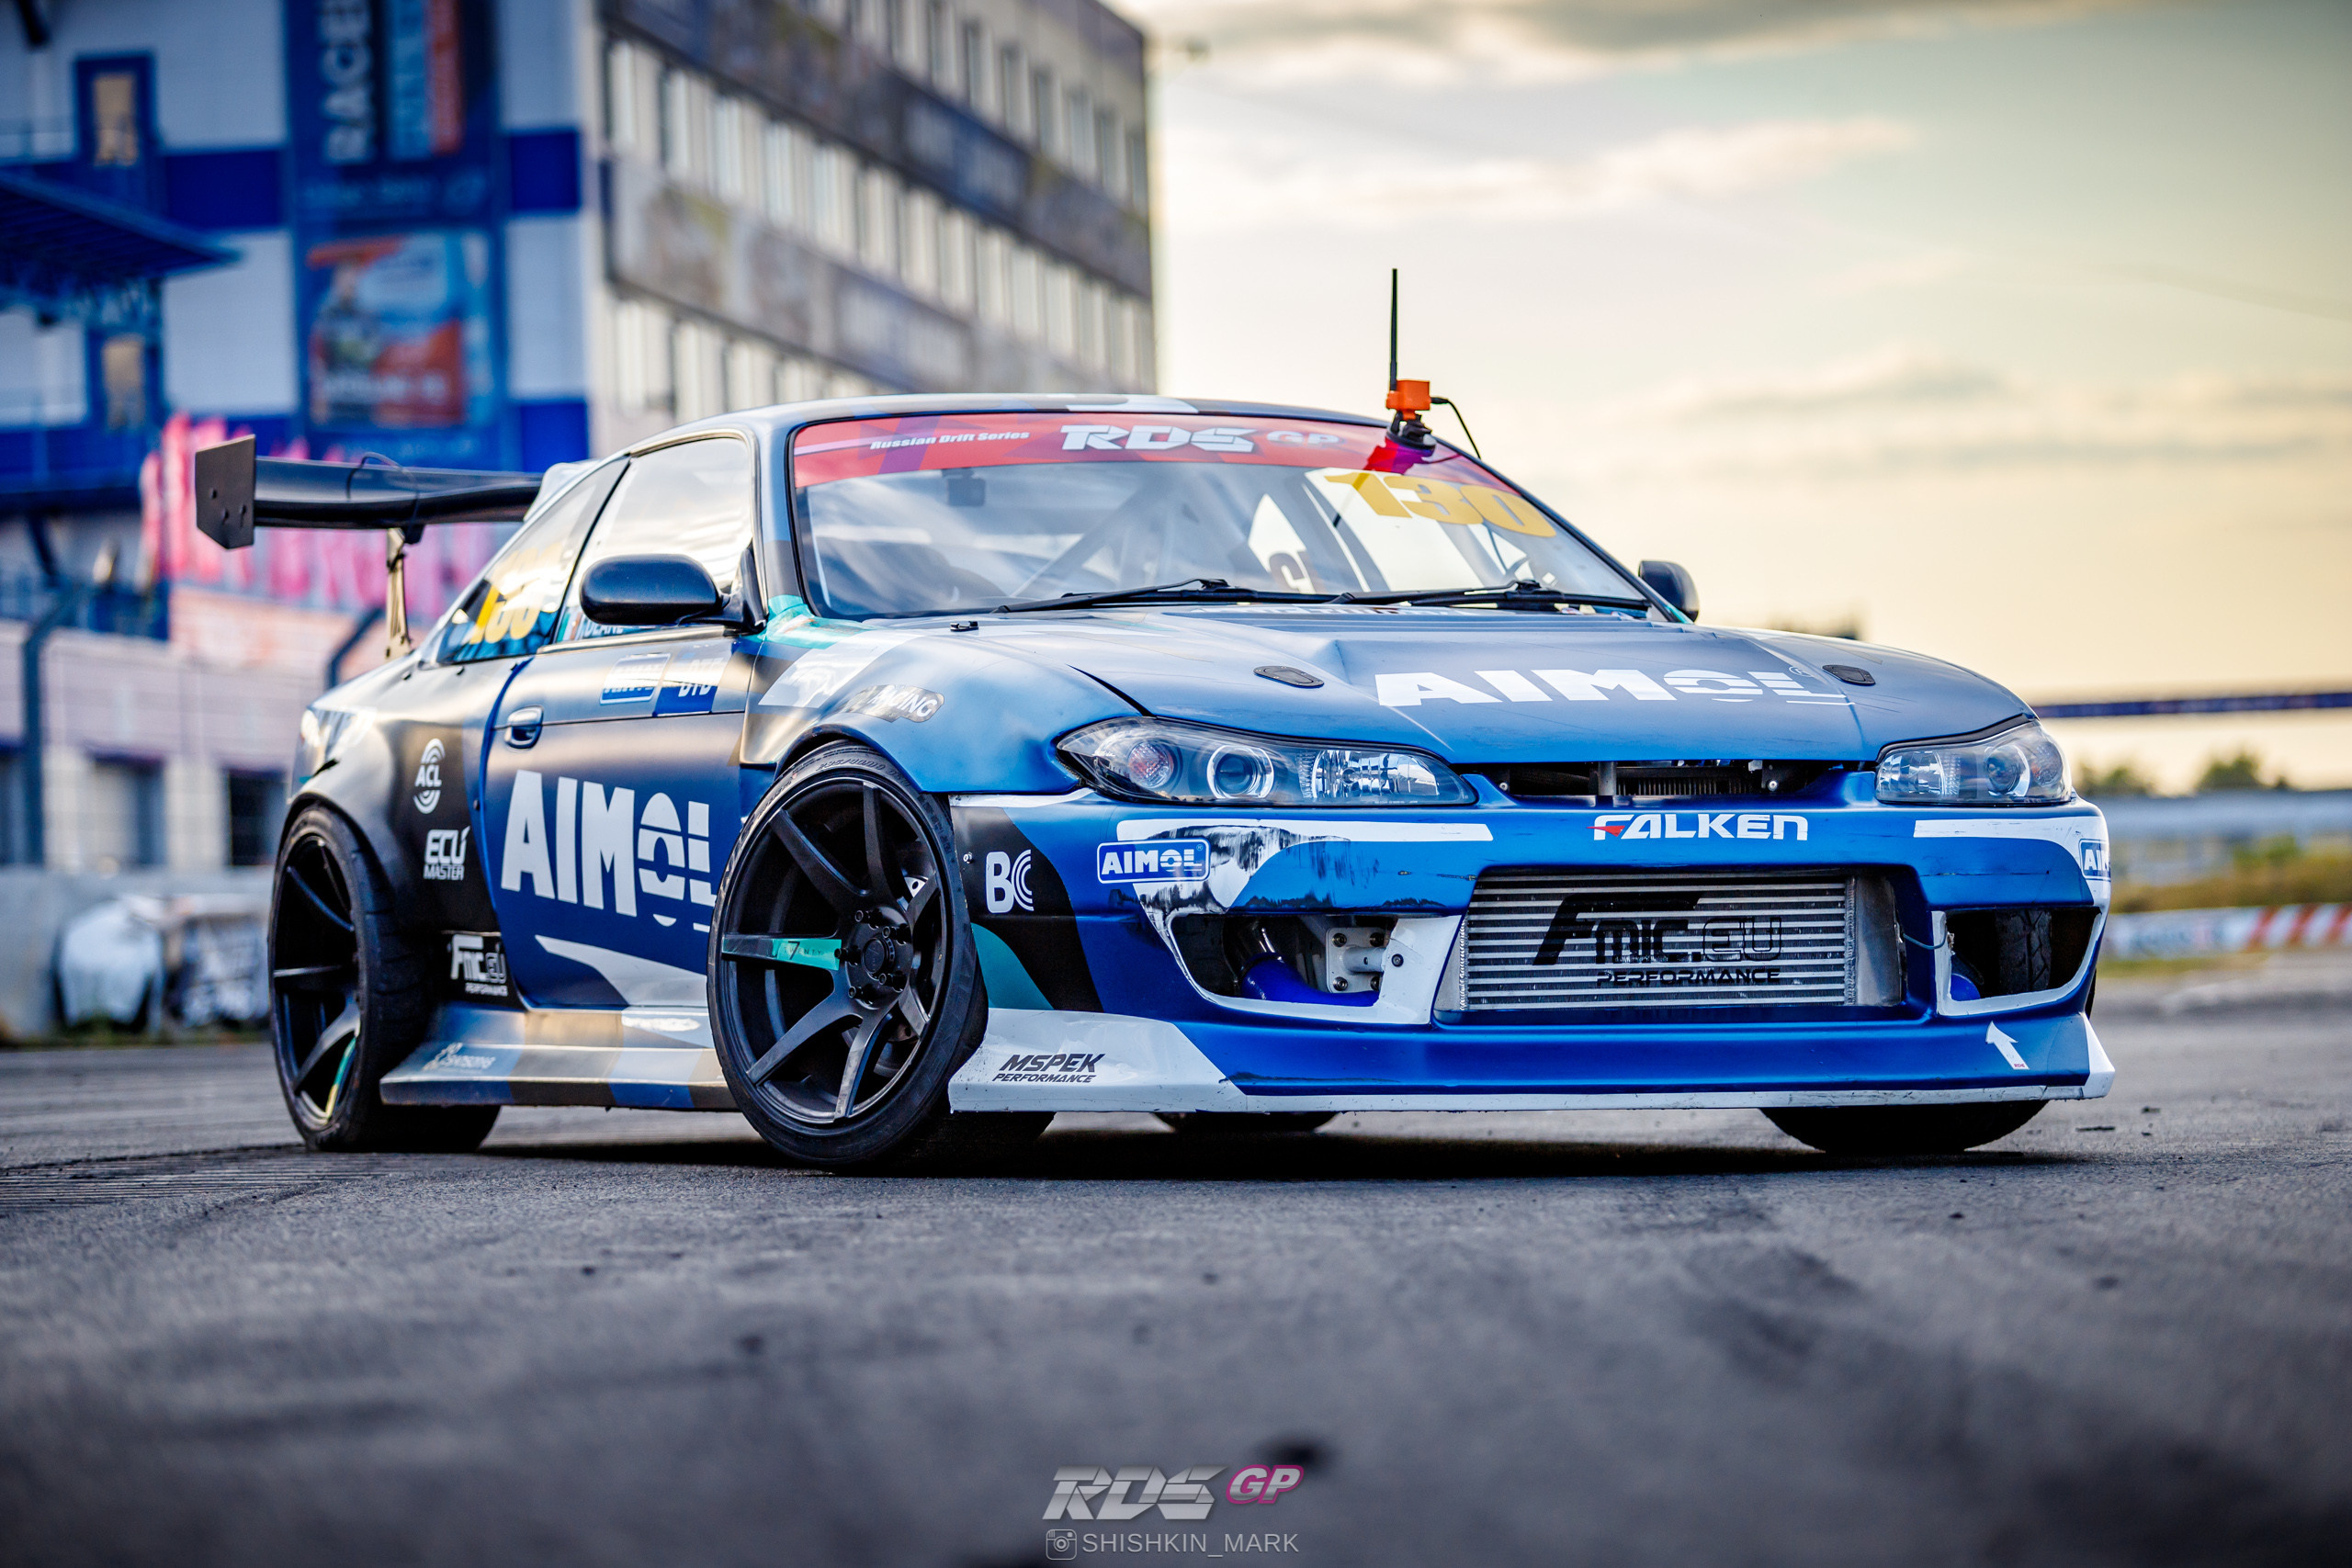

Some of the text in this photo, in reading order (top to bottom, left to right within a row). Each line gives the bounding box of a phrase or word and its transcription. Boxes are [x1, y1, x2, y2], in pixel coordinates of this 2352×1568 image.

[869, 432, 1031, 449] Russian Drift Series
[1059, 424, 1342, 452] RDS GP
[1324, 471, 1556, 537] 130
[1374, 669, 1855, 705] AIMOL
[414, 765, 442, 787] ACL
[1587, 813, 1808, 840] FALKEN
[424, 826, 470, 864] ECU
[501, 769, 717, 932] AIMOL
[423, 863, 464, 881] MASTER
[1102, 849, 1202, 874] AIMOL
[1597, 968, 1780, 986] PERFORMANCE
[999, 1054, 1105, 1073] MSPEK
[992, 1073, 1097, 1083] PERFORMANCE
